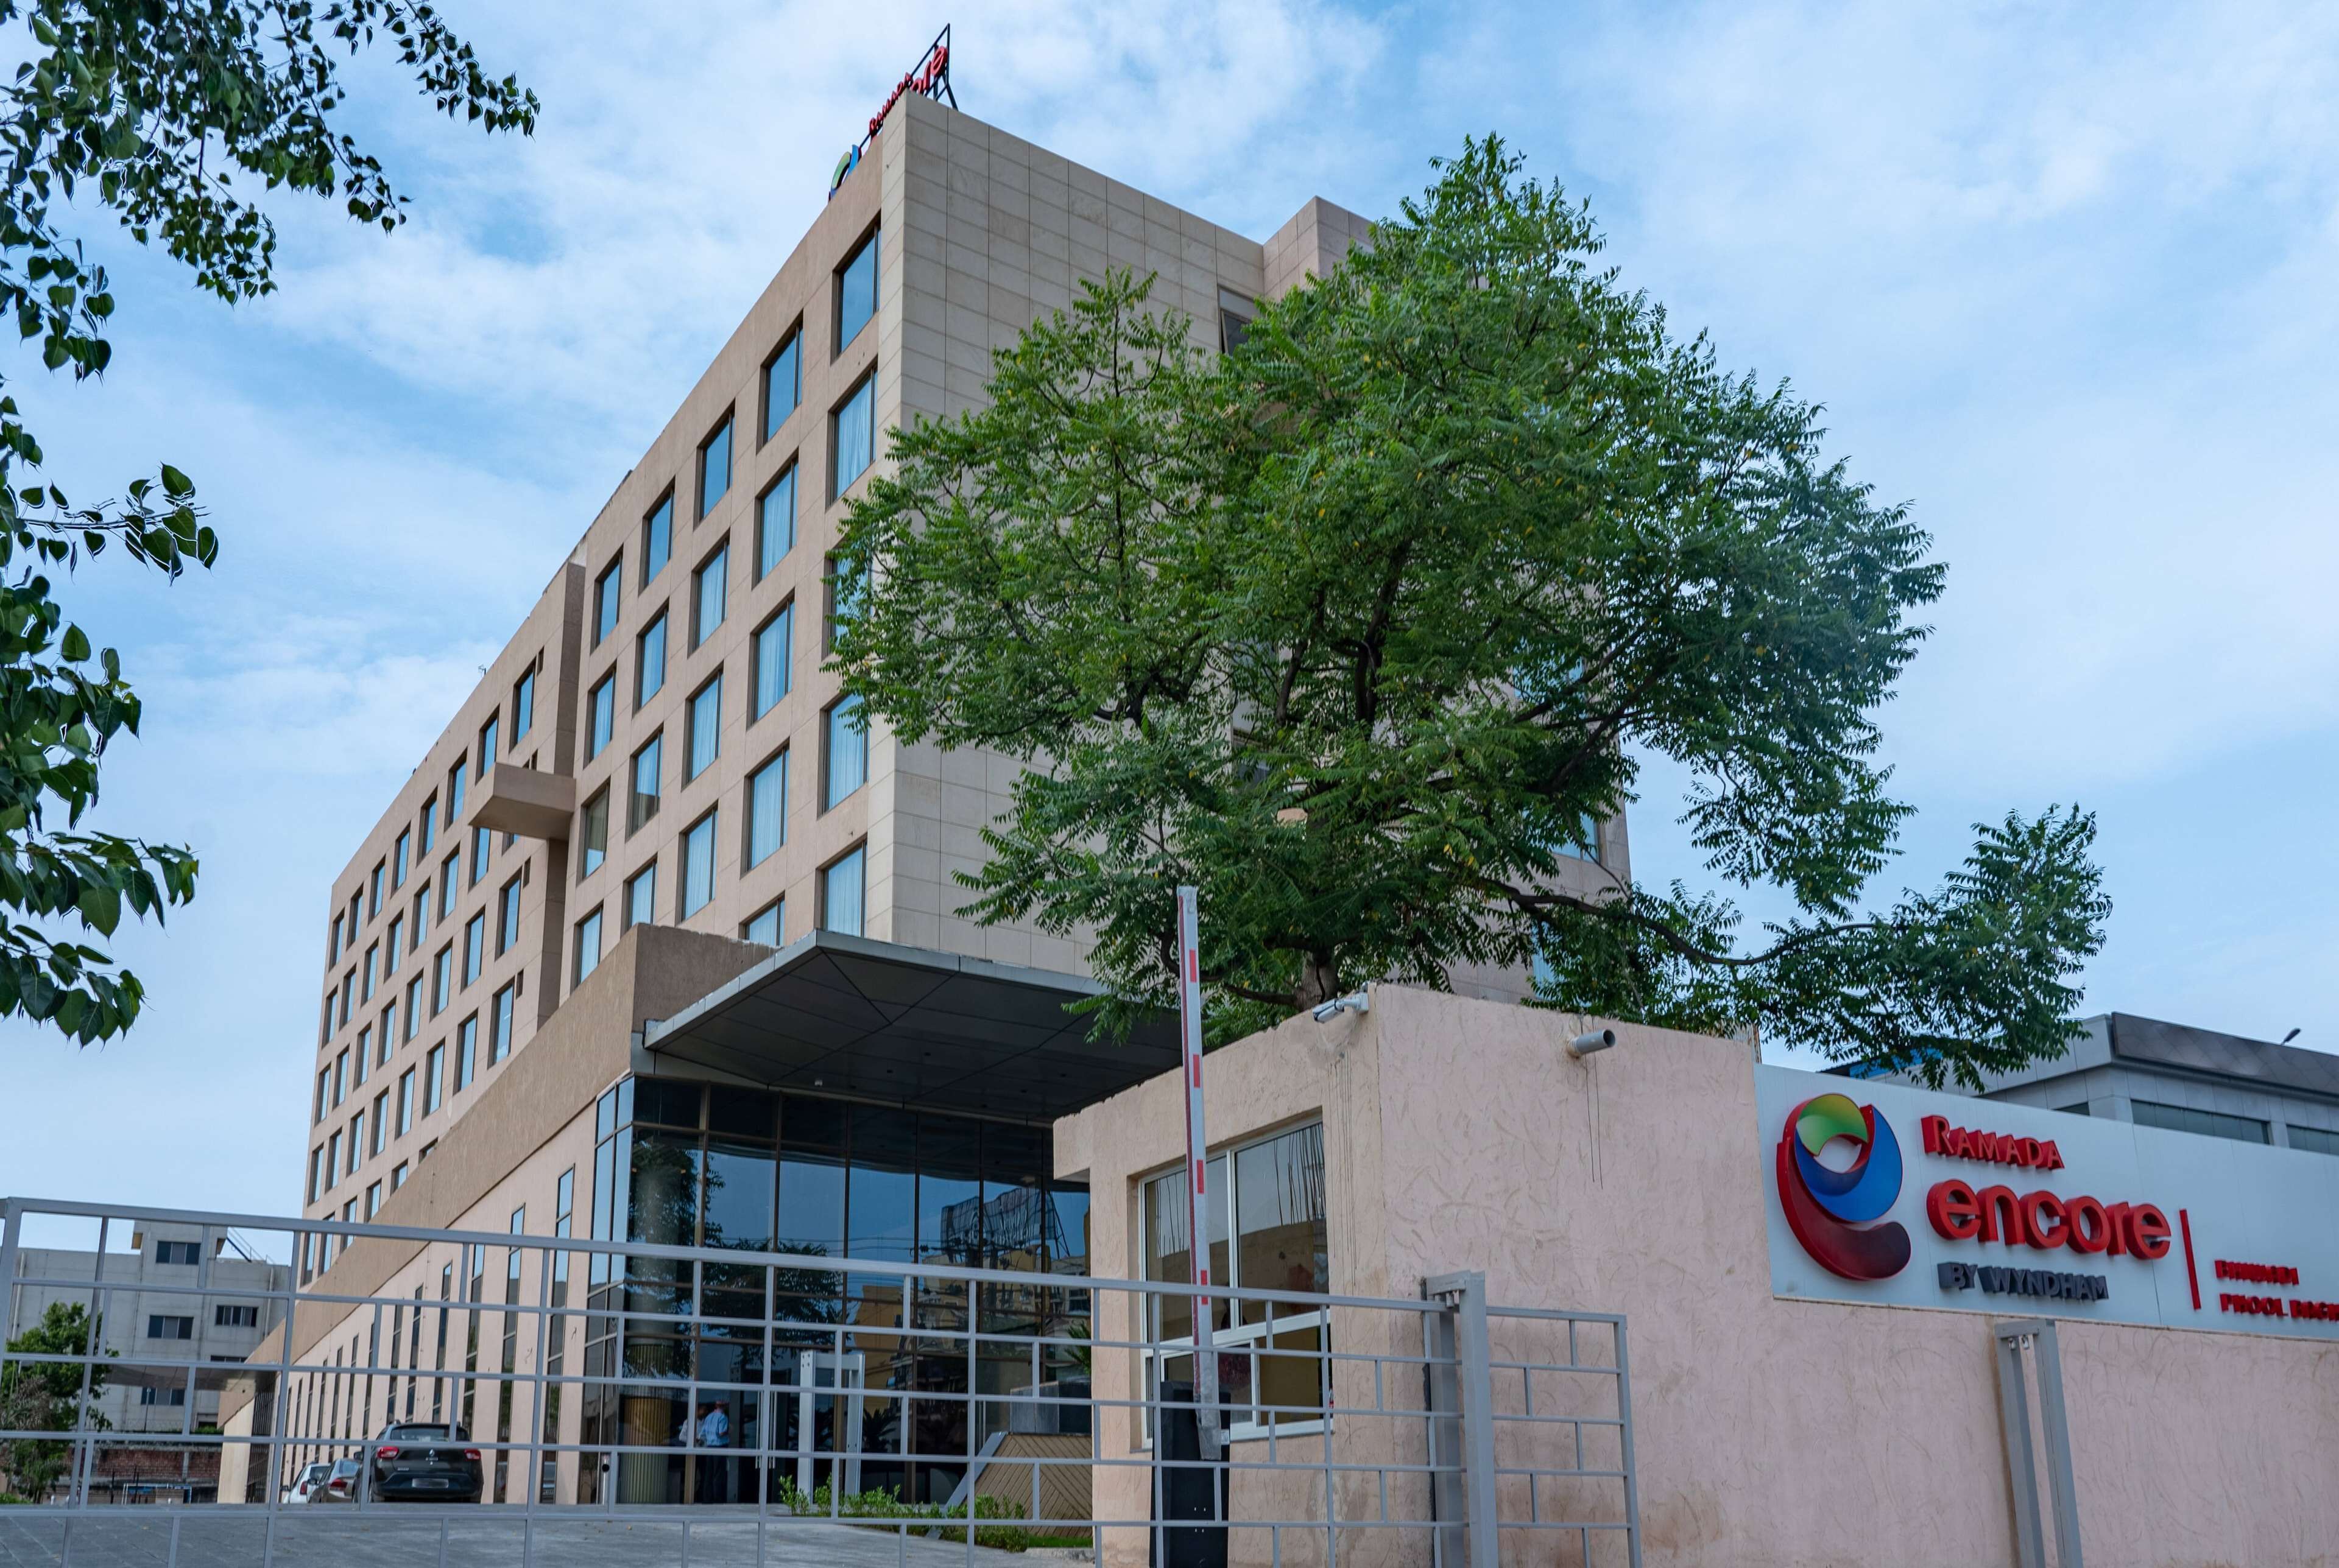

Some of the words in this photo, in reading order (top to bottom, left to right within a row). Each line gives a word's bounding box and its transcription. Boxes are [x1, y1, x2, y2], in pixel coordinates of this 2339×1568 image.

[1921, 1115, 2065, 1170] RAMADA
[1927, 1178, 2171, 1260] encore
[1937, 1261, 1978, 1290] BY
[1977, 1266, 2109, 1301] WYNDHAM
